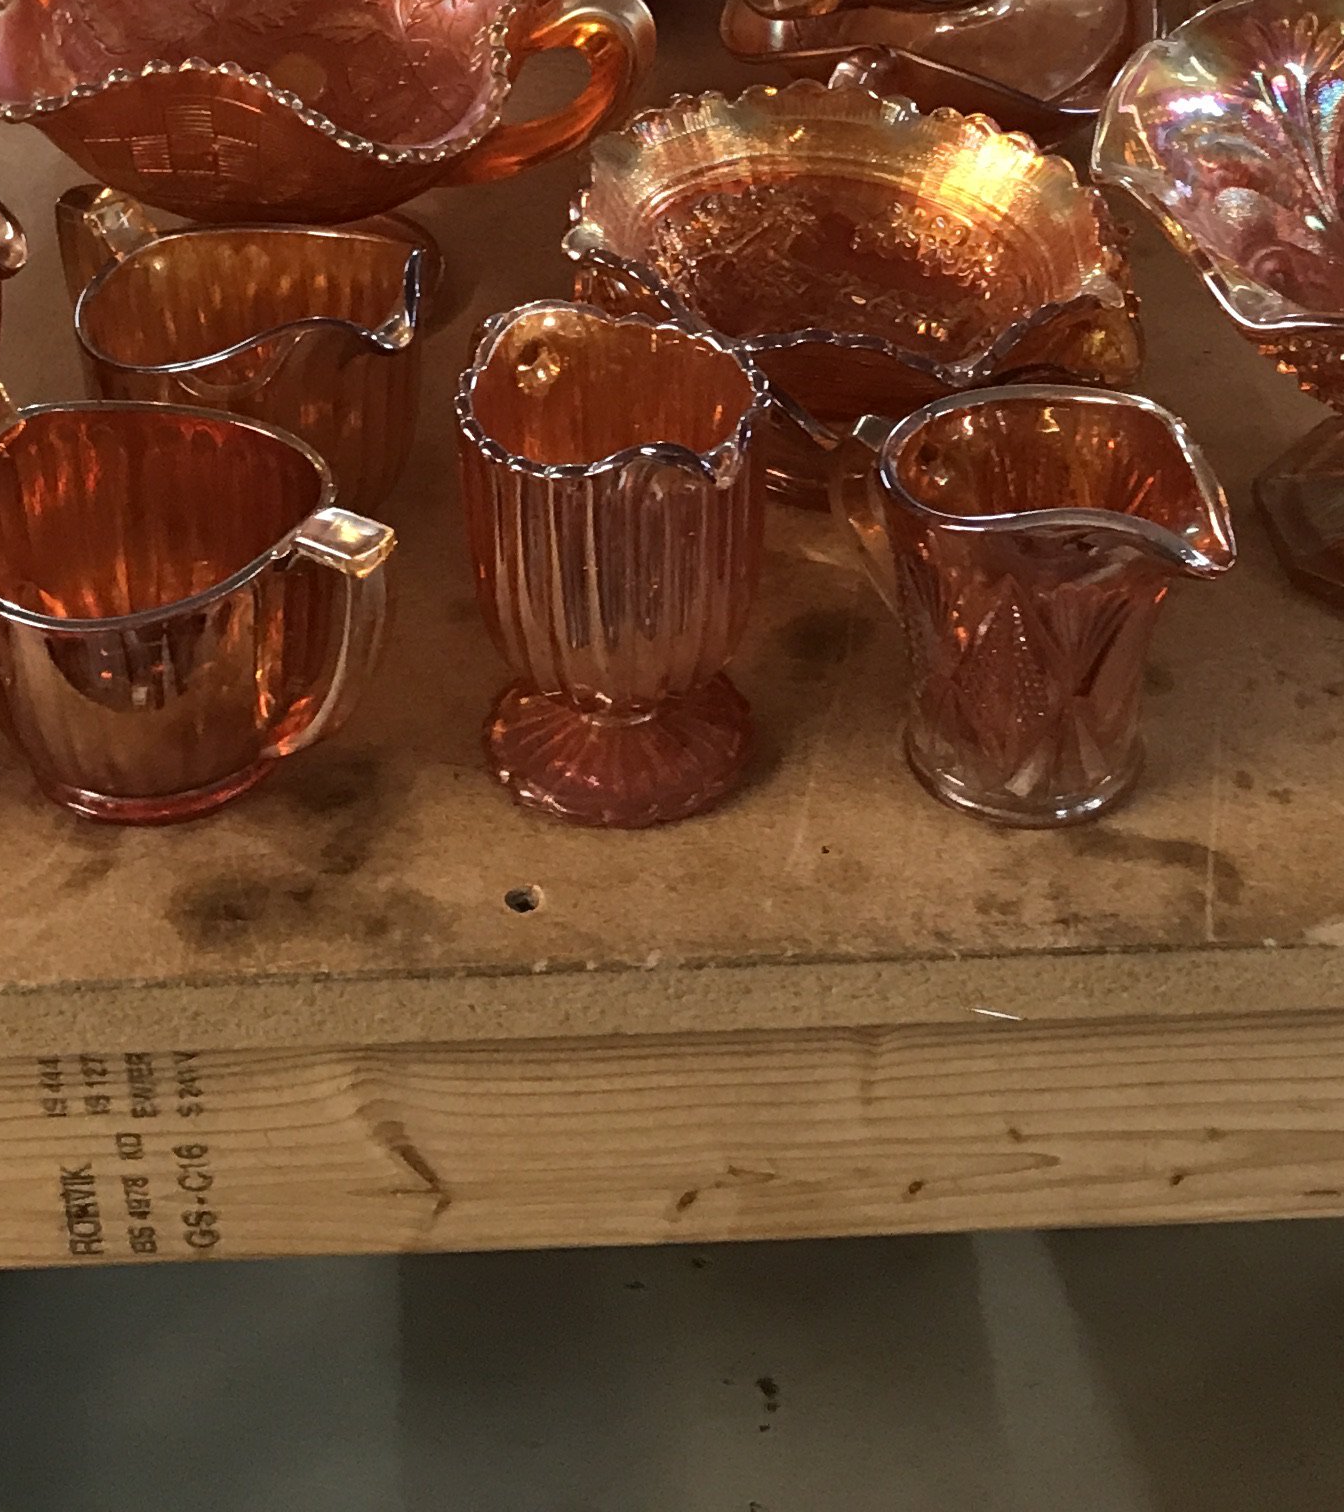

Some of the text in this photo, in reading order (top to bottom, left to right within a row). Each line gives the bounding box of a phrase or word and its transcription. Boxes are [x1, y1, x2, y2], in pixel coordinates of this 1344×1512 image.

[114, 1131, 158, 1255] BS 4978 KD
